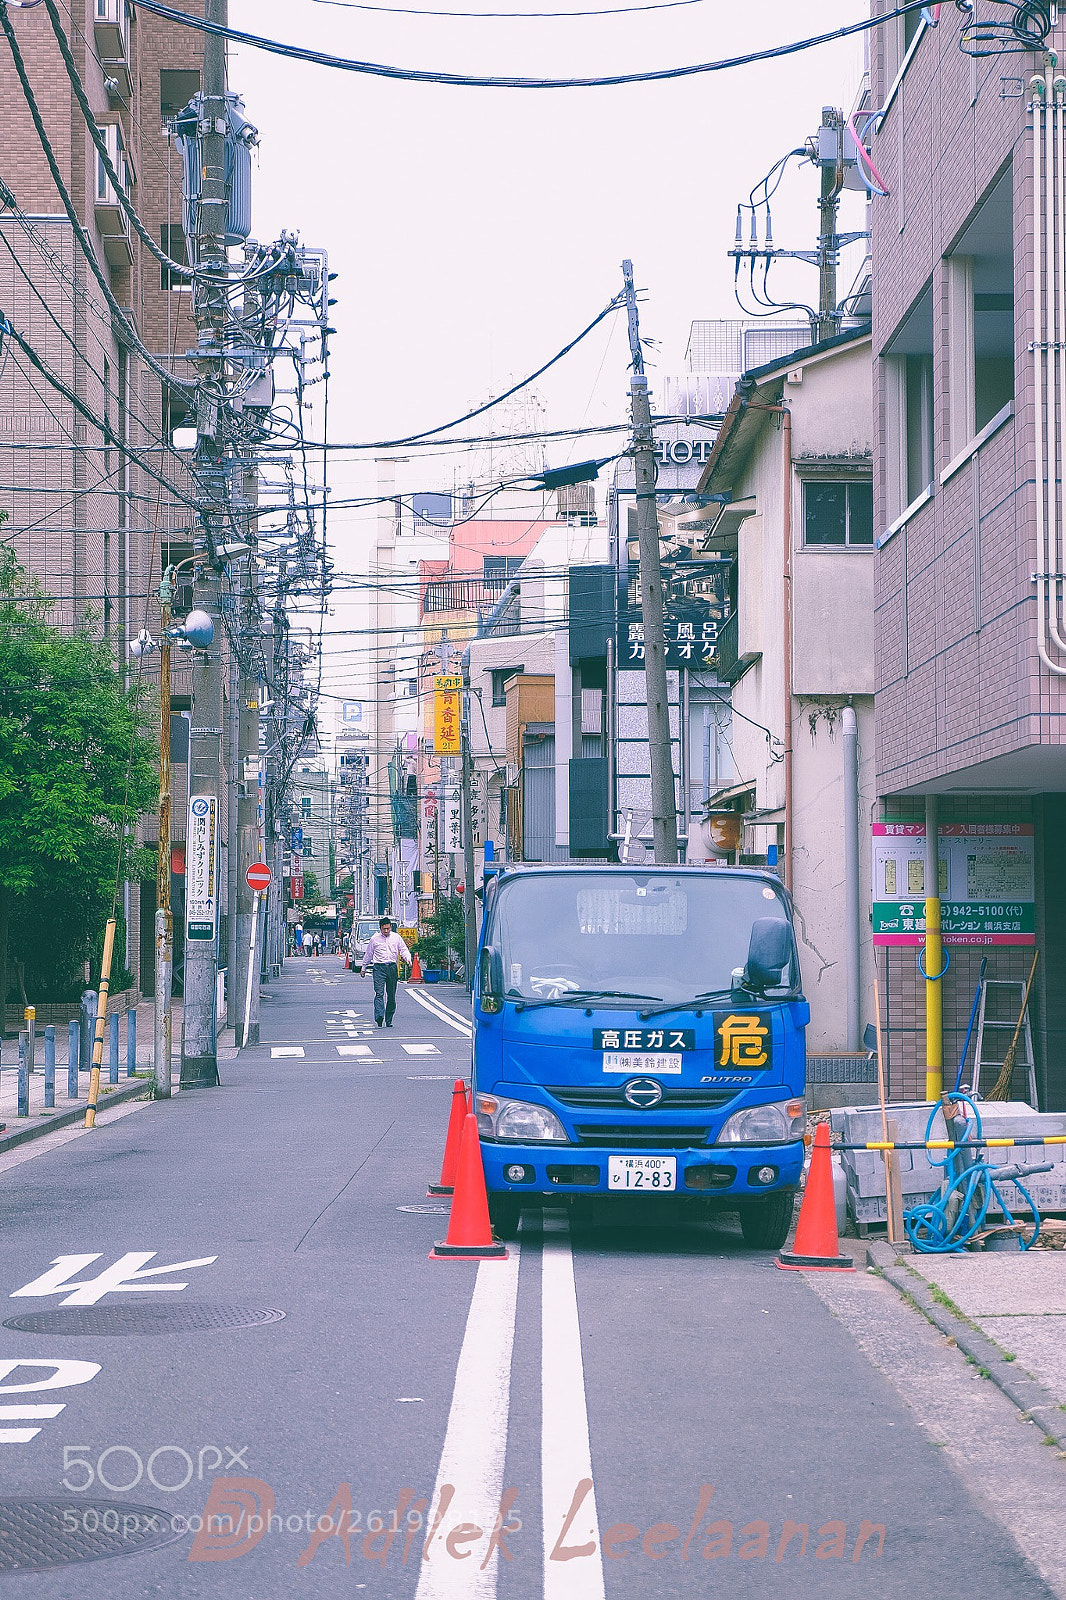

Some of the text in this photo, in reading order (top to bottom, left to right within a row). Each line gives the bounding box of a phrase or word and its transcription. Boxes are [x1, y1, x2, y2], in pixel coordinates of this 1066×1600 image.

[884, 824, 955, 835] 賃貸マンョン
[902, 918, 981, 931] 東建ポレーション
[984, 921, 1021, 931] 横浜支店
[600, 1030, 687, 1049] 高圧ガス
[717, 1015, 769, 1067] 危
[626, 1170, 672, 1188] 12-83
